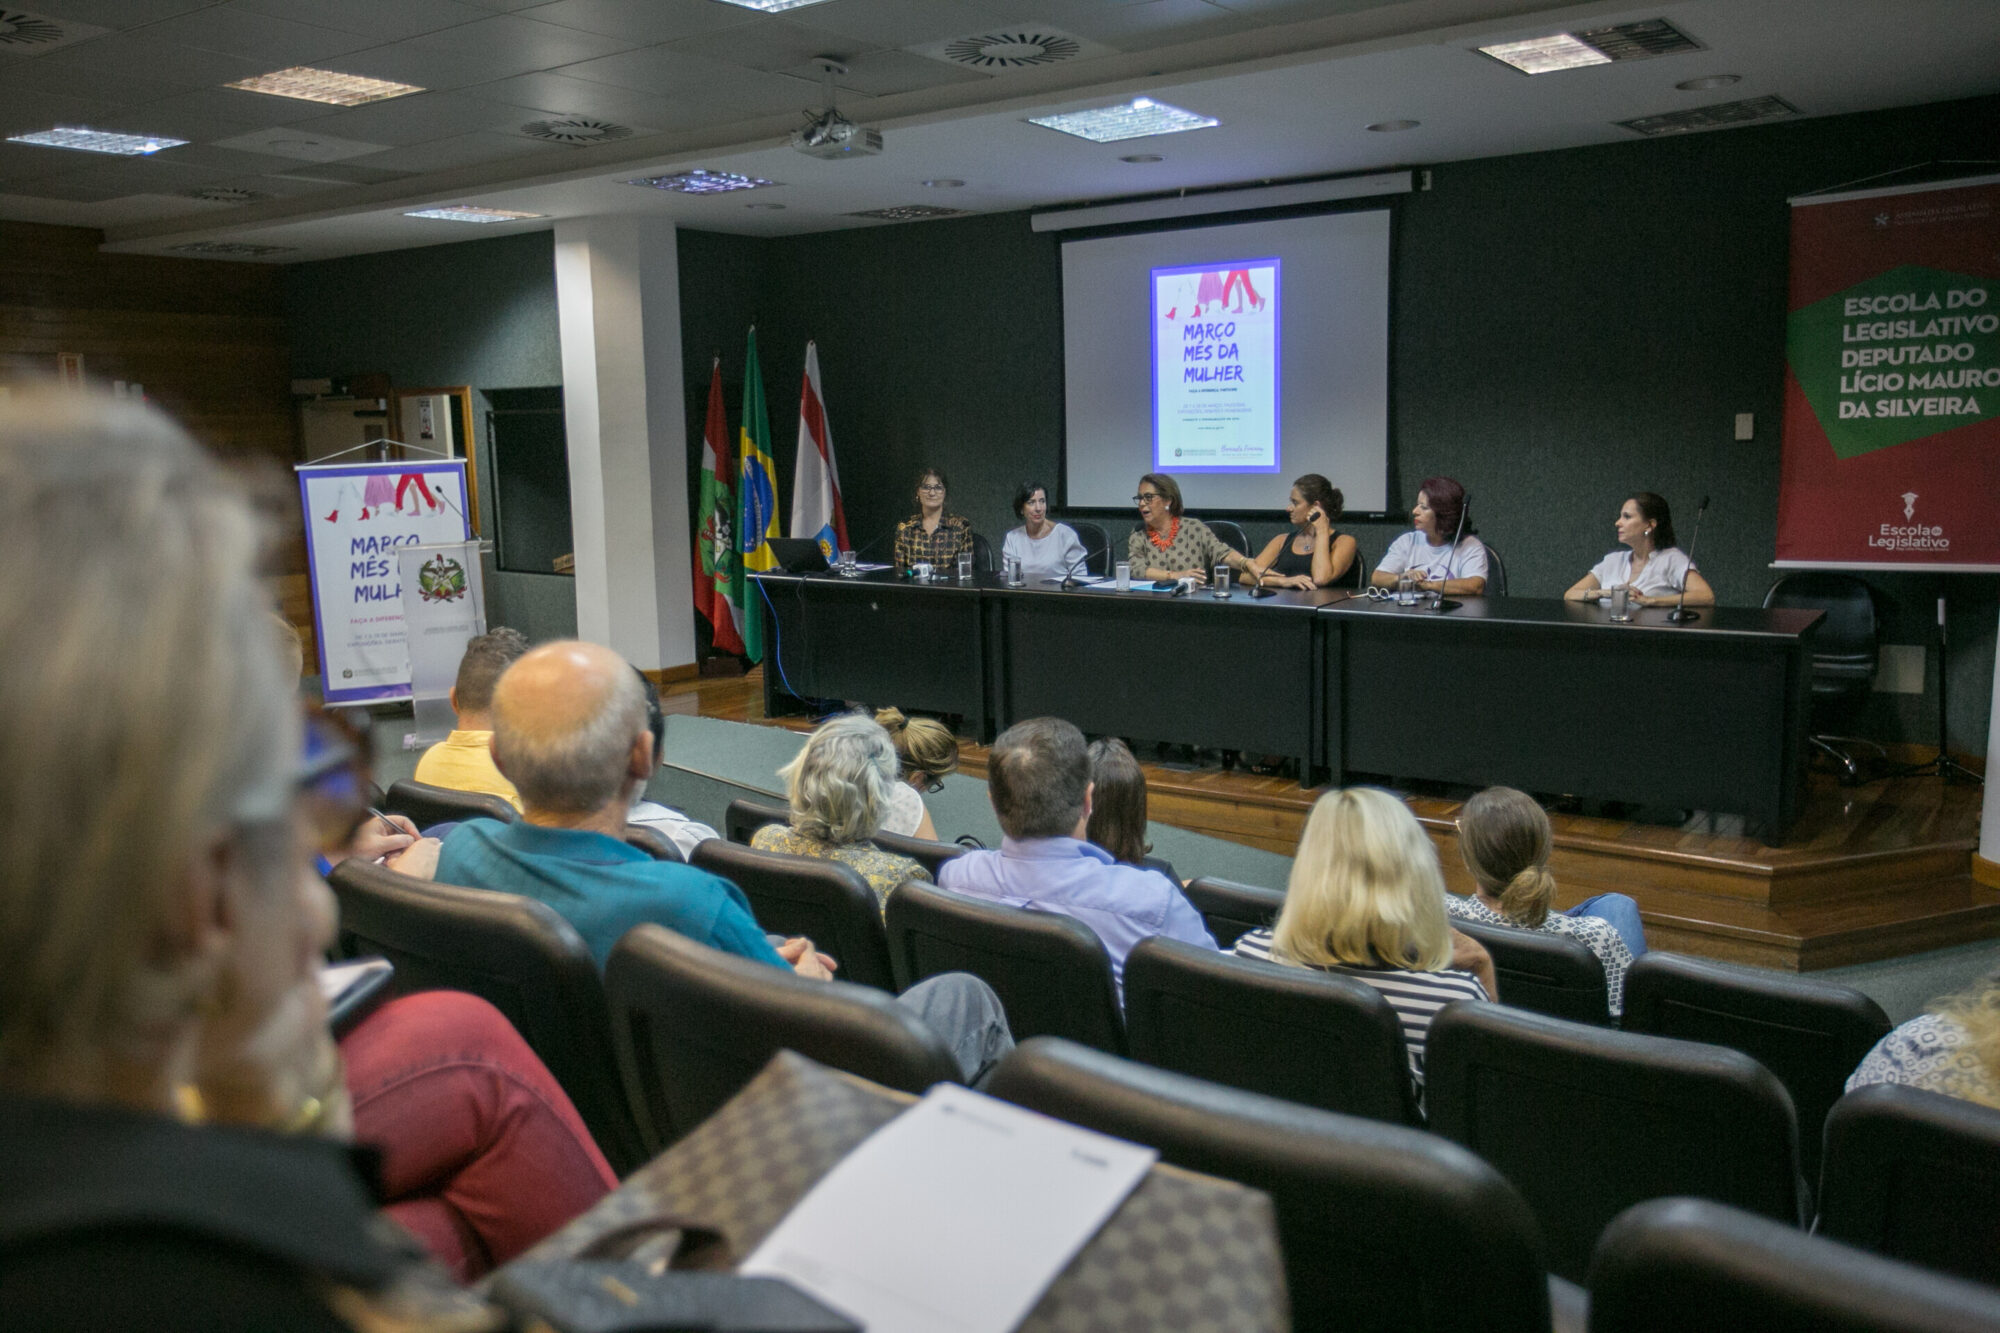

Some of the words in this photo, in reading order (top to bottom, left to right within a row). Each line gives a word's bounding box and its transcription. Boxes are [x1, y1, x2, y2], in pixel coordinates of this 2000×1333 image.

[1844, 291, 1941, 316] ESCOLA
[1947, 288, 1987, 309] DO
[1183, 321, 1236, 342] MARÇO
[1843, 314, 2000, 342] LEGISLATIVO
[1218, 342, 1239, 361] DA
[1842, 343, 1975, 368] DEPUTADO
[1184, 365, 1244, 384] MULHER
[1840, 370, 1904, 393] LÍCIO
[1908, 368, 2000, 390] MAURO
[1838, 400, 1871, 419] DA
[1875, 396, 1981, 417] SILVEIRA
[1880, 523, 1930, 536] Escola
[1868, 535, 1950, 550] Legislativo
[350, 555, 390, 579] MÊS
